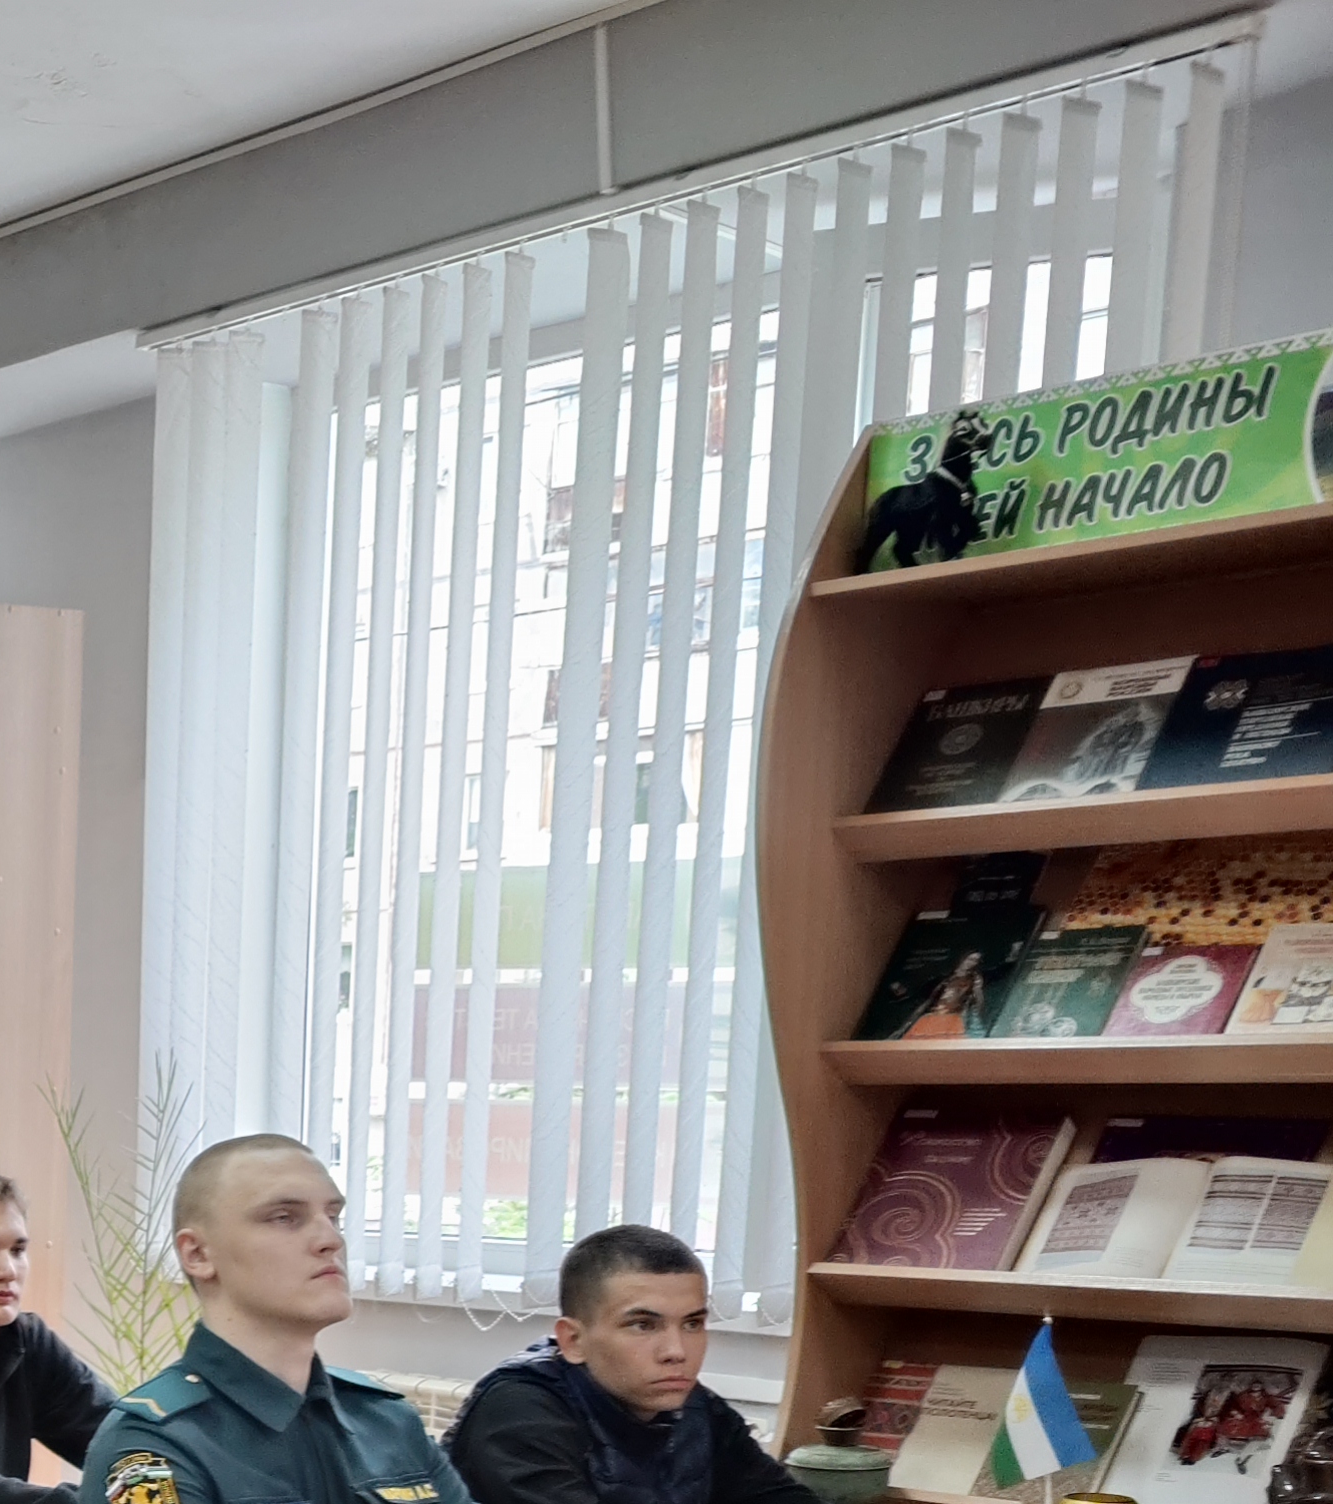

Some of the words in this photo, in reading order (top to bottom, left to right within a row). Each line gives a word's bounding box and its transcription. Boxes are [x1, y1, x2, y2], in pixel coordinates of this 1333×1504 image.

[903, 414, 1042, 484] ЗСЬ
[1055, 364, 1278, 456] РОДИНЫ
[1037, 451, 1230, 531] НАЧАЛО
